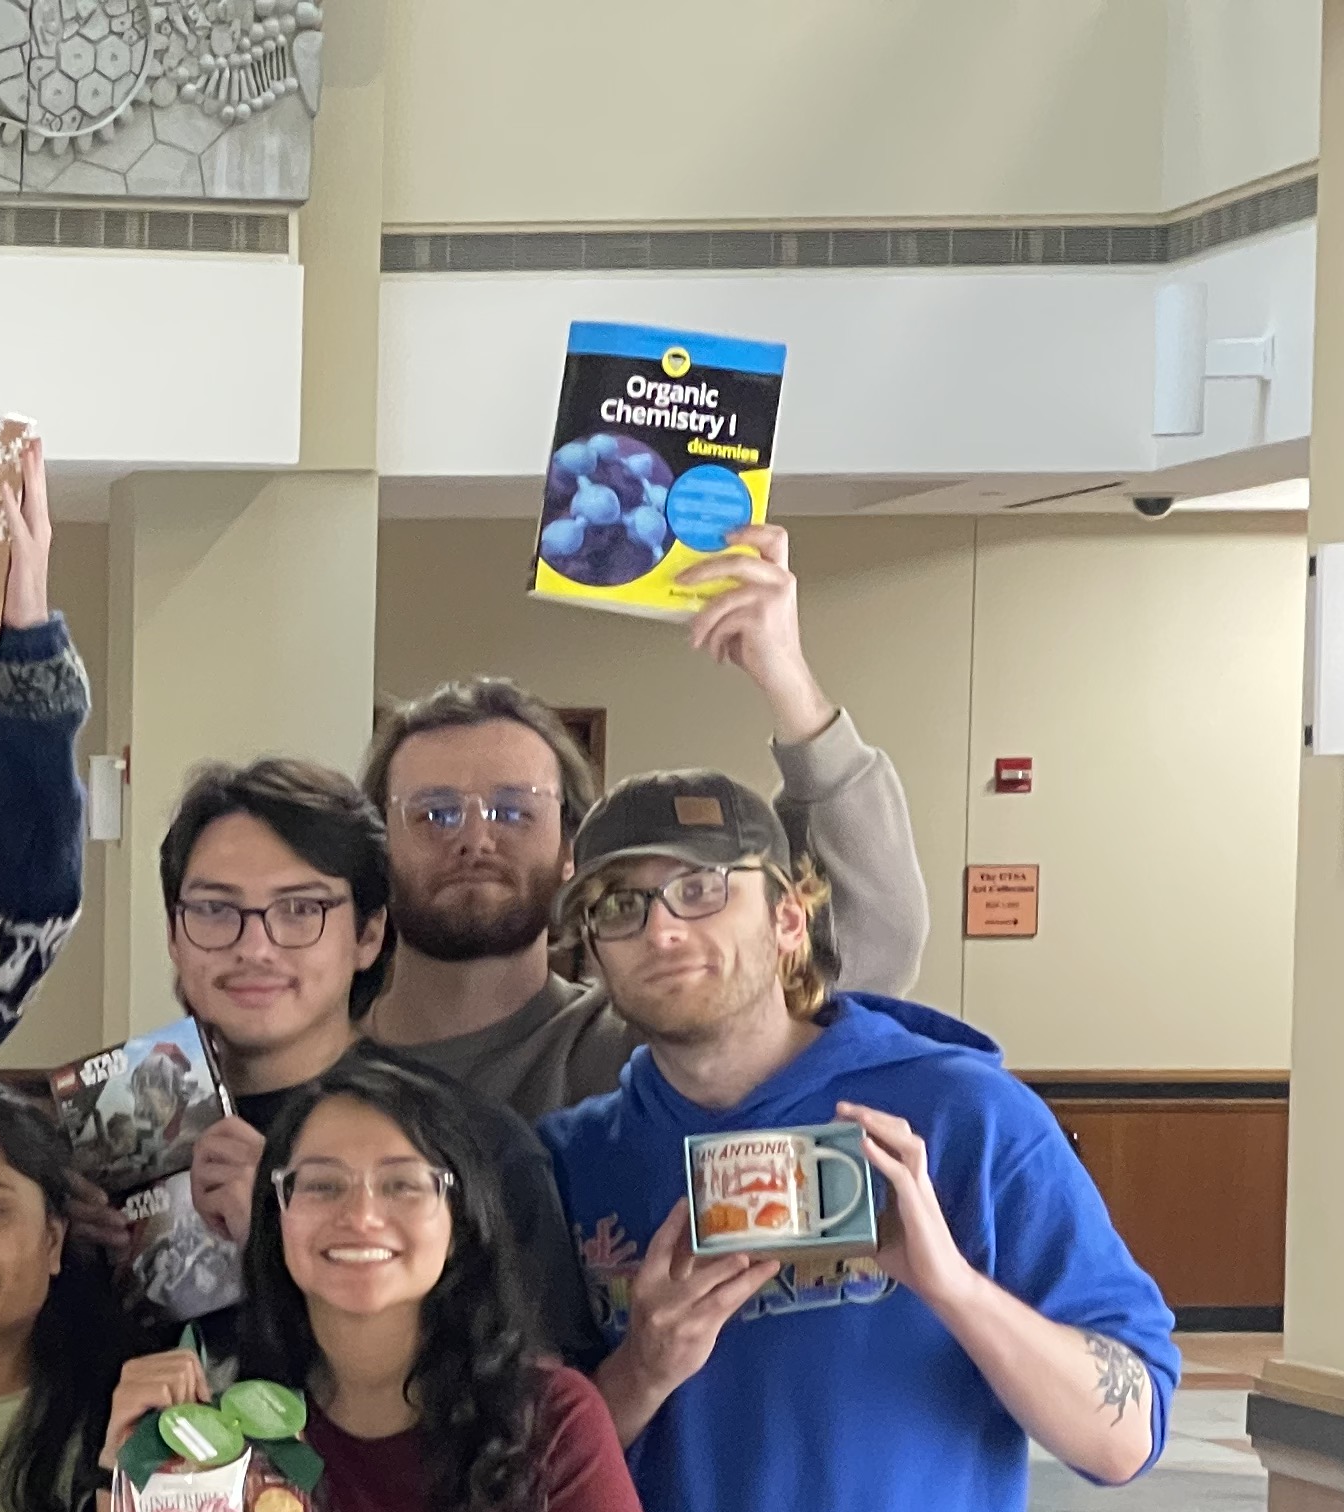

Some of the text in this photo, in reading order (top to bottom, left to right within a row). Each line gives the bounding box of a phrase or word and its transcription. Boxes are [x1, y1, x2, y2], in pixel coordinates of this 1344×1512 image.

[625, 374, 720, 411] Organic
[600, 397, 738, 440] Chemistry I
[687, 436, 760, 464] dummies
